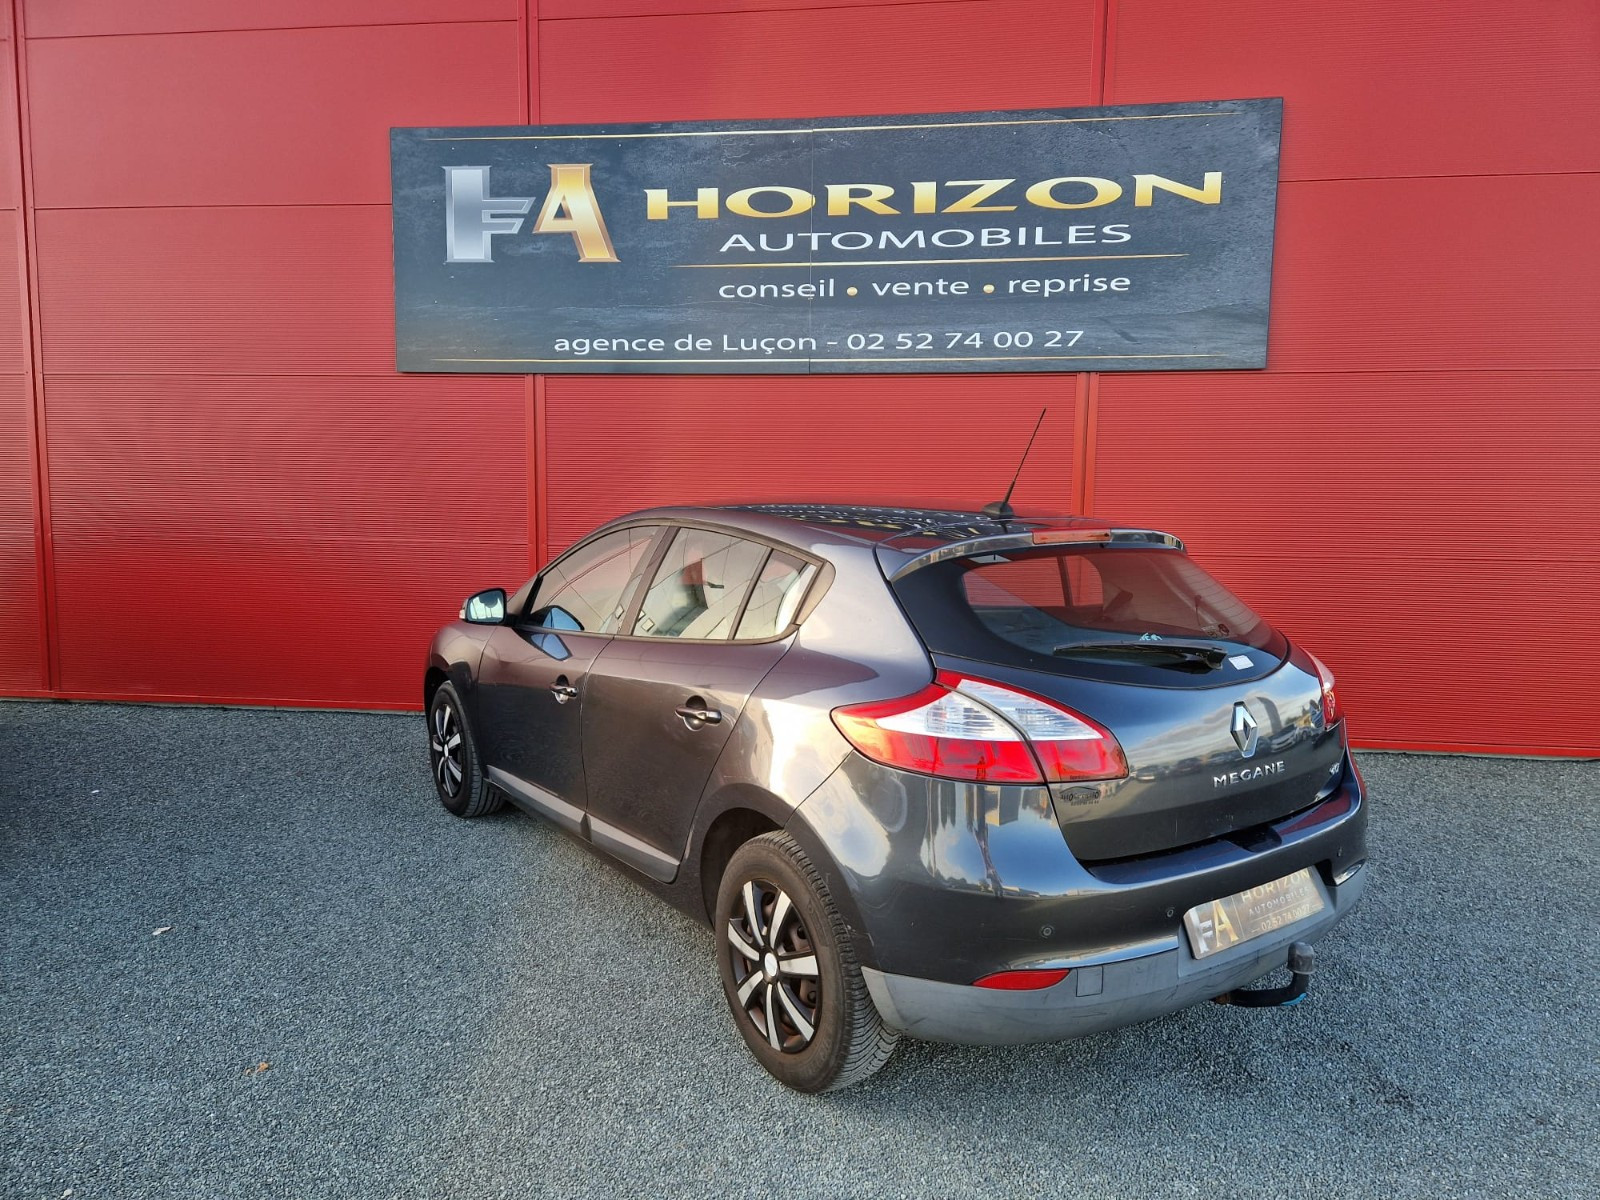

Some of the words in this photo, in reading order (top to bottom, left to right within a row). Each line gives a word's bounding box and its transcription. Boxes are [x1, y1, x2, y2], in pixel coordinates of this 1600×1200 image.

[644, 171, 1223, 220] HORIZON
[719, 223, 1132, 252] AUTOMOBILES
[718, 278, 835, 298] conseil
[872, 278, 970, 297] vente
[1008, 273, 1131, 298] reprise
[554, 336, 663, 355] agence
[674, 335, 713, 352] de
[723, 334, 817, 355] Luçon
[847, 333, 885, 350] 02
[895, 333, 935, 349] 52
[945, 332, 984, 348] 74
[993, 331, 1034, 348] 00
[1044, 330, 1084, 347] 27
[1213, 760, 1286, 788] MEGANE
[1240, 868, 1311, 903] HORIZON
[1248, 886, 1311, 917] AUTOMOBILES
